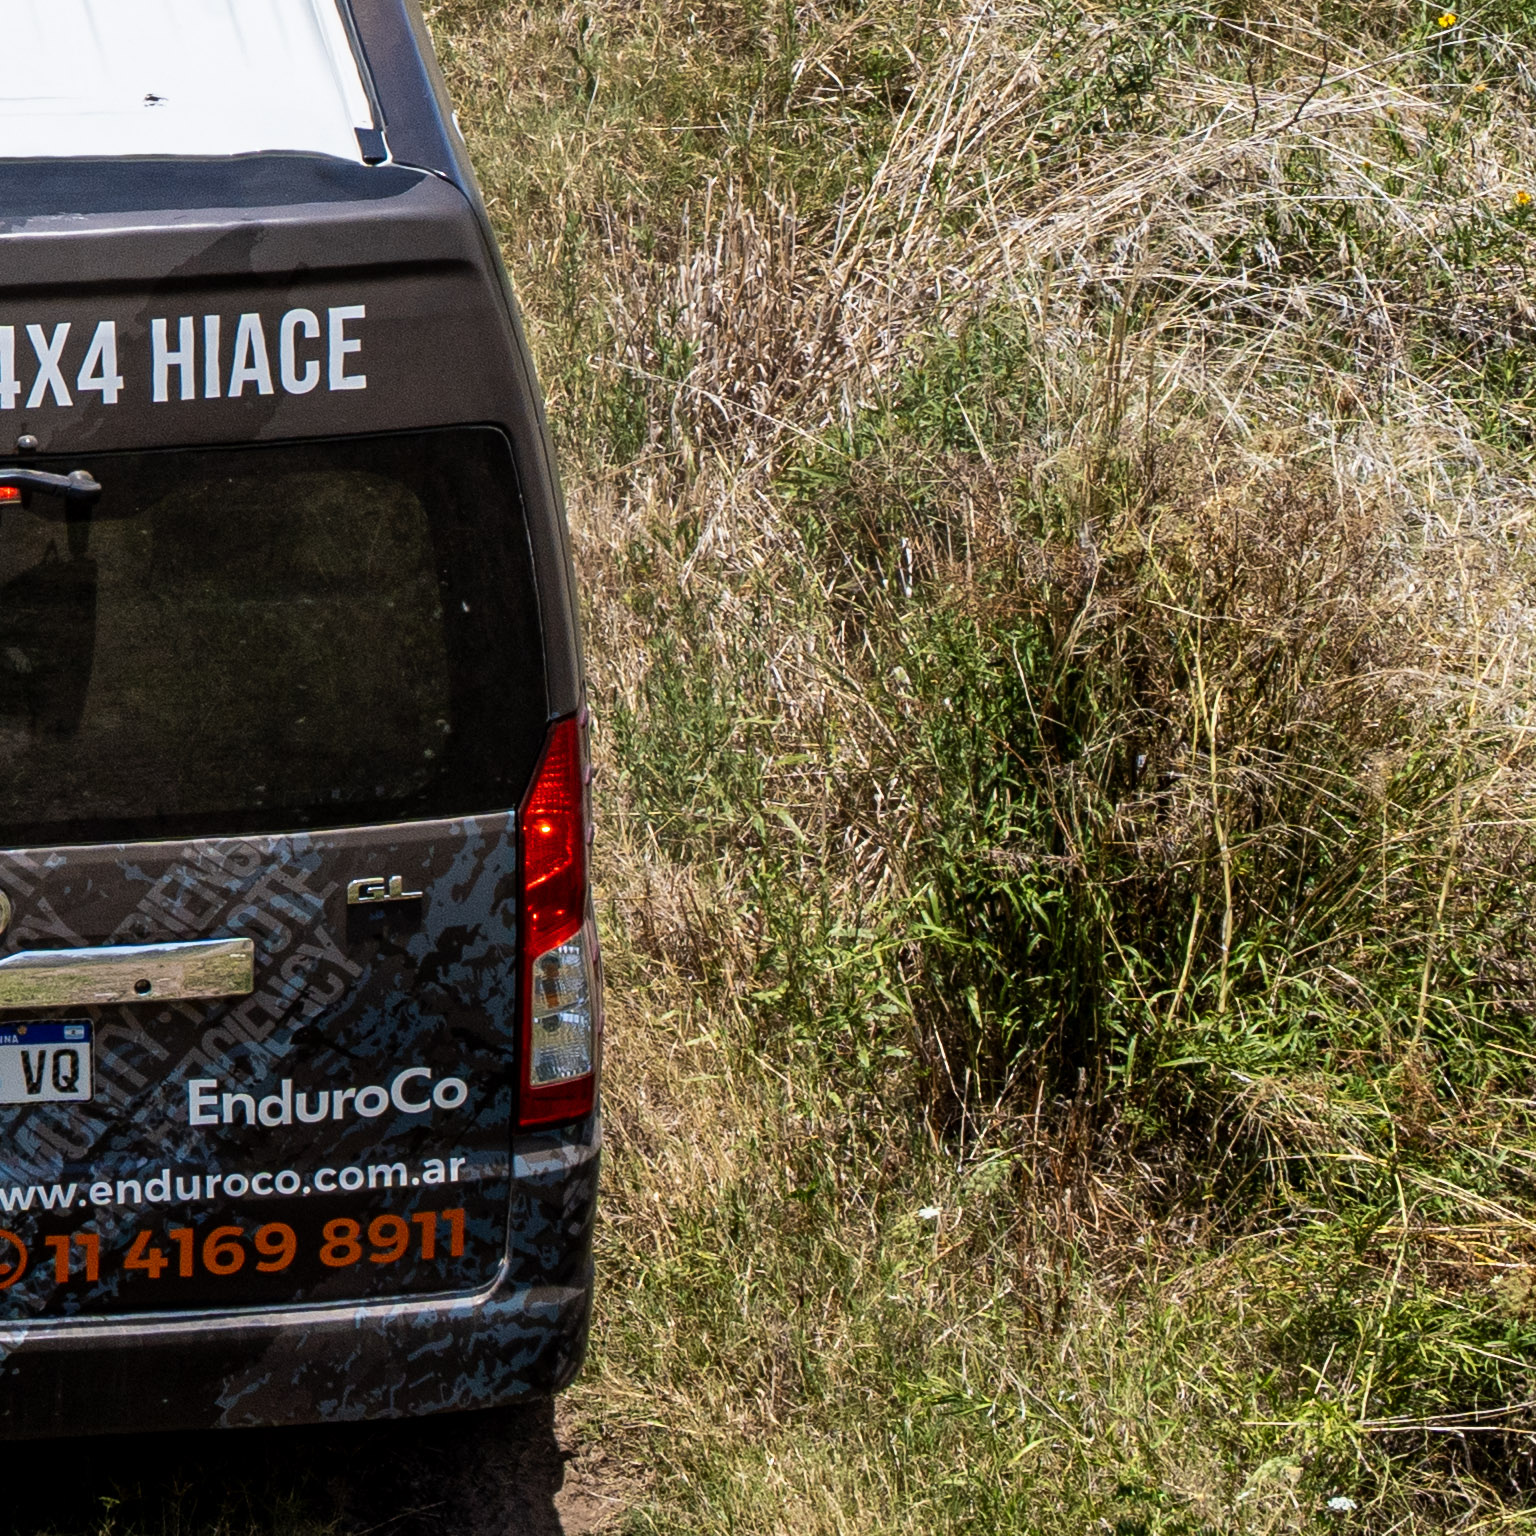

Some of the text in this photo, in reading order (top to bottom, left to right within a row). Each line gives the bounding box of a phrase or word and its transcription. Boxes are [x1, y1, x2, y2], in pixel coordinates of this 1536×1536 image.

[151, 304, 367, 404] HIACE
[346, 874, 424, 906] GL
[20, 1048, 80, 1096] VQ
[186, 1066, 470, 1130] EnduroCo
[44, 1207, 468, 1284] 11 4169 8911
